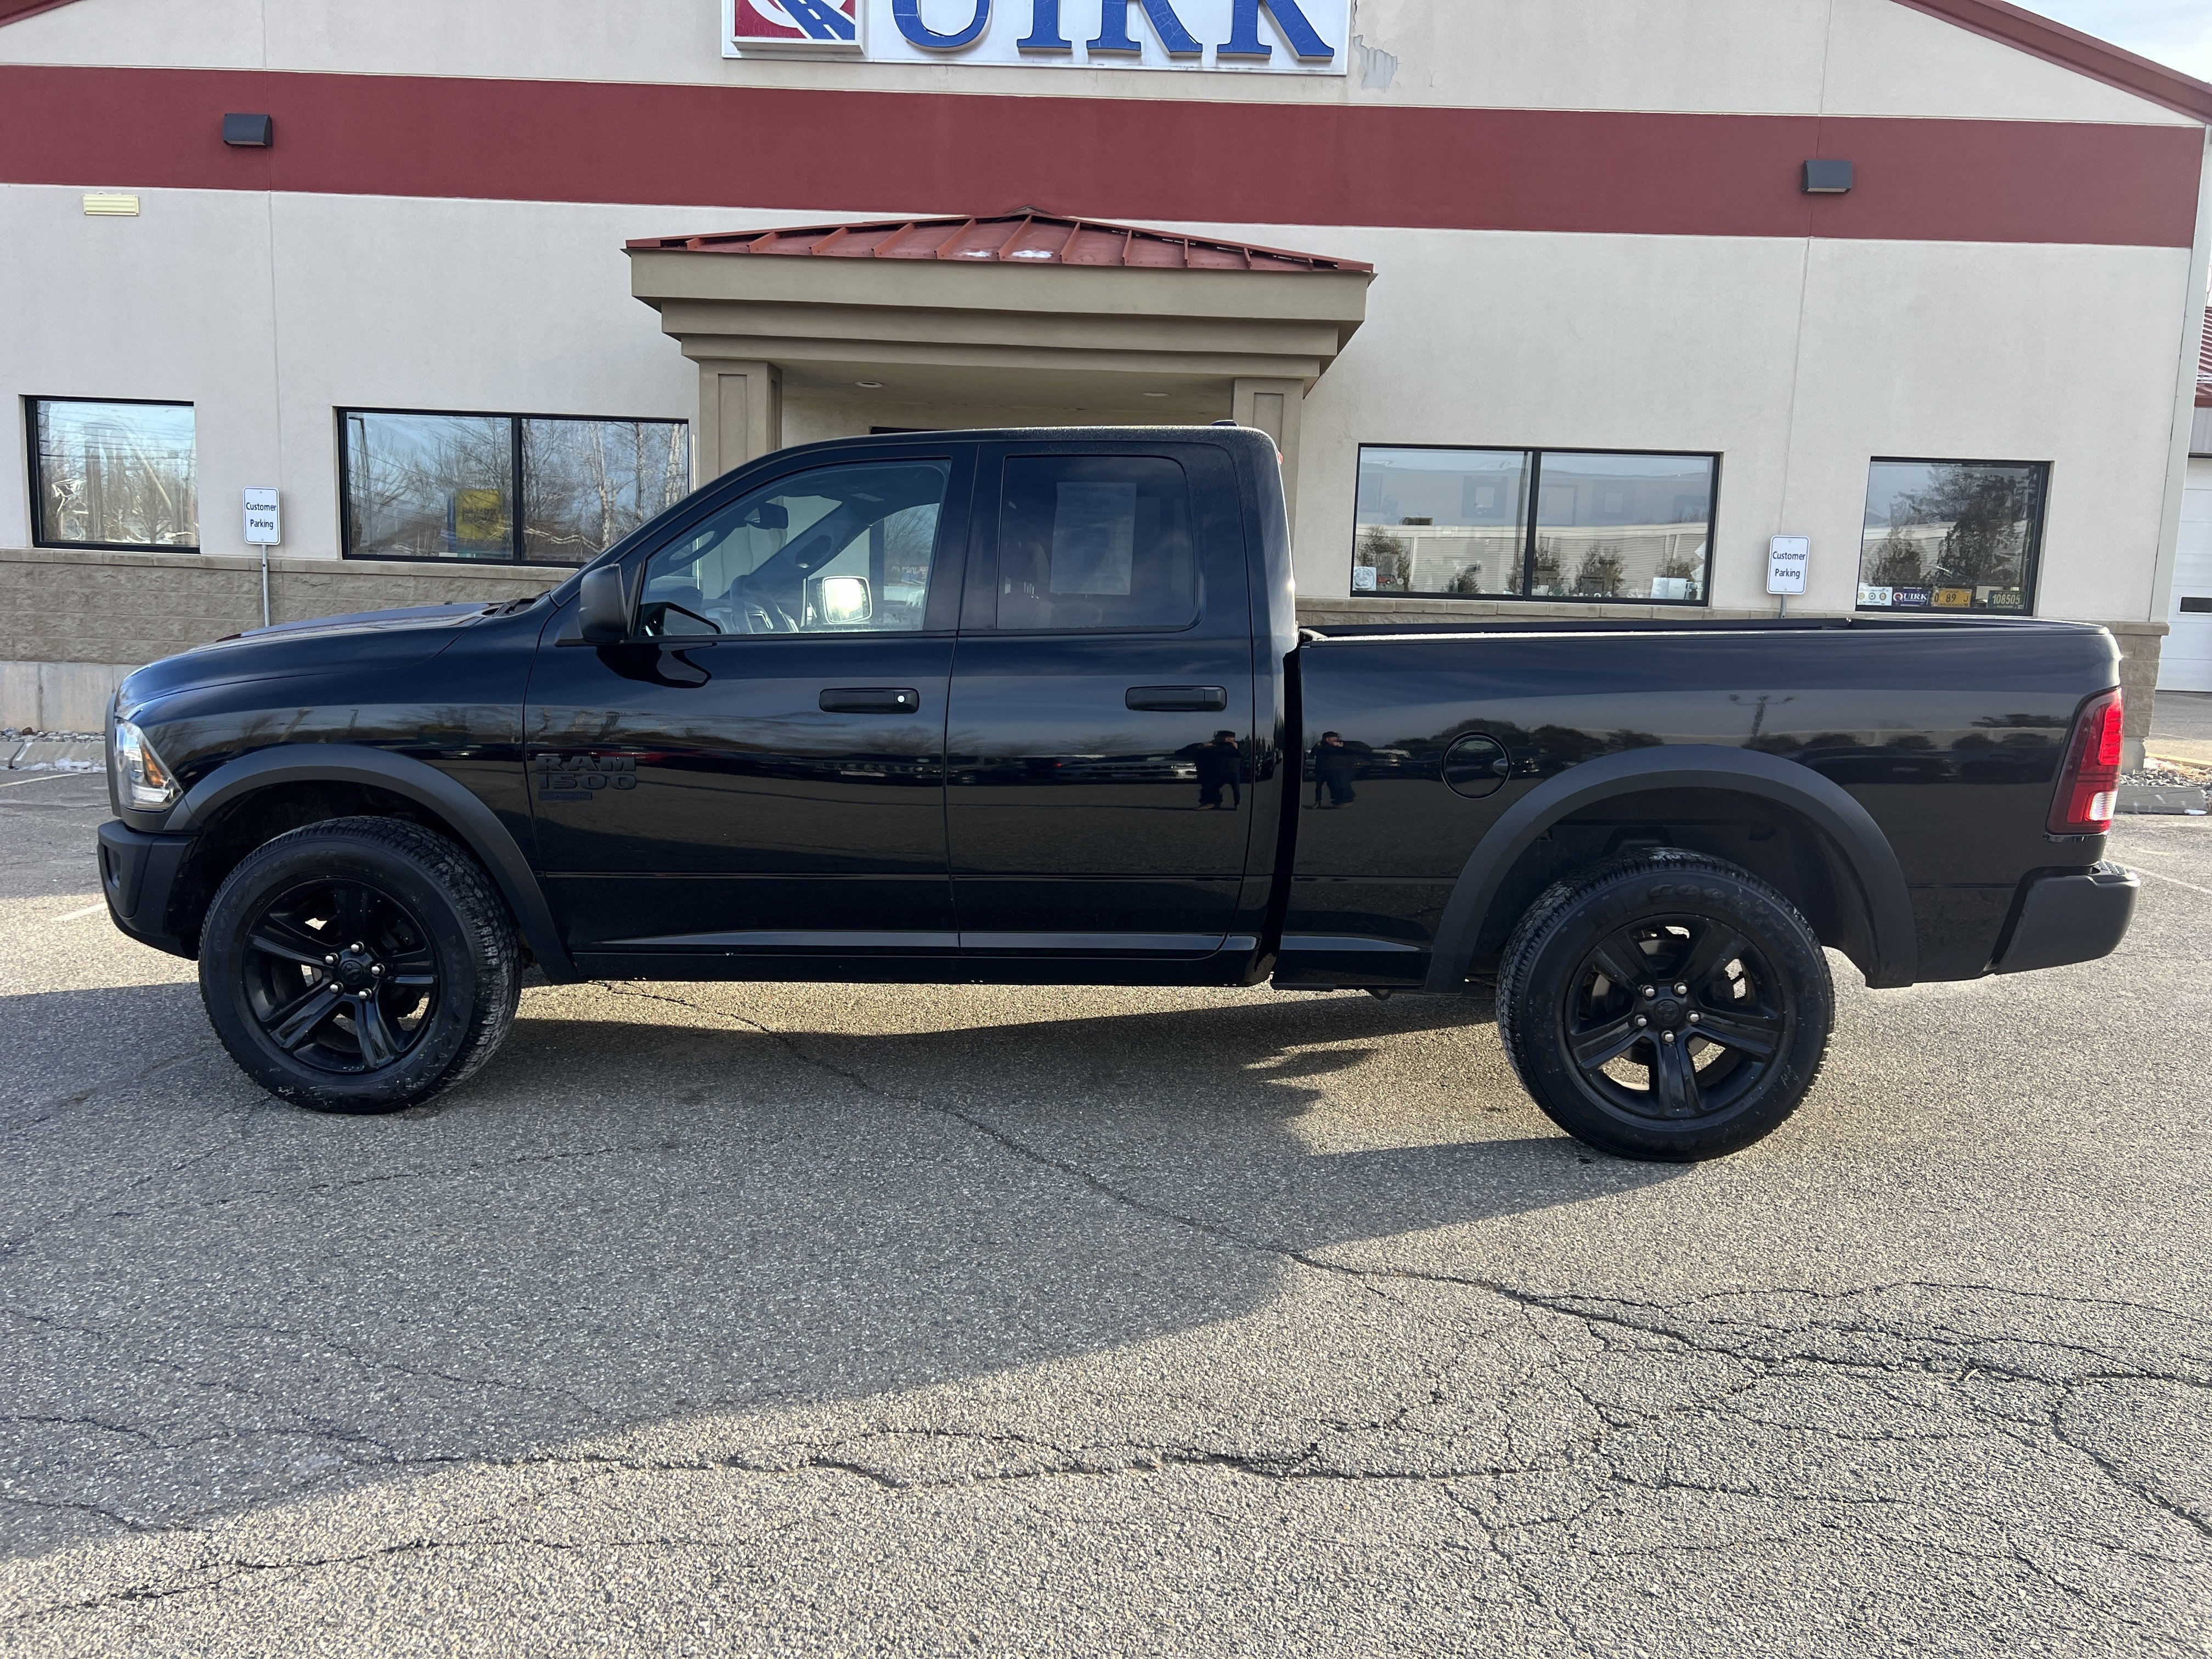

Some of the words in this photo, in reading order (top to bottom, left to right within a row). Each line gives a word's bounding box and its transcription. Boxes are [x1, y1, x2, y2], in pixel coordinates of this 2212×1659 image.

[246, 502, 276, 511] Customer
[250, 519, 273, 530] Parking
[1773, 551, 1805, 560] Customer
[1775, 568, 1800, 579] Parking
[1893, 592, 1928, 602] QUIRK
[1992, 594, 2021, 605] 108505
[535, 755, 636, 771] RAM
[537, 773, 637, 791] 1500
